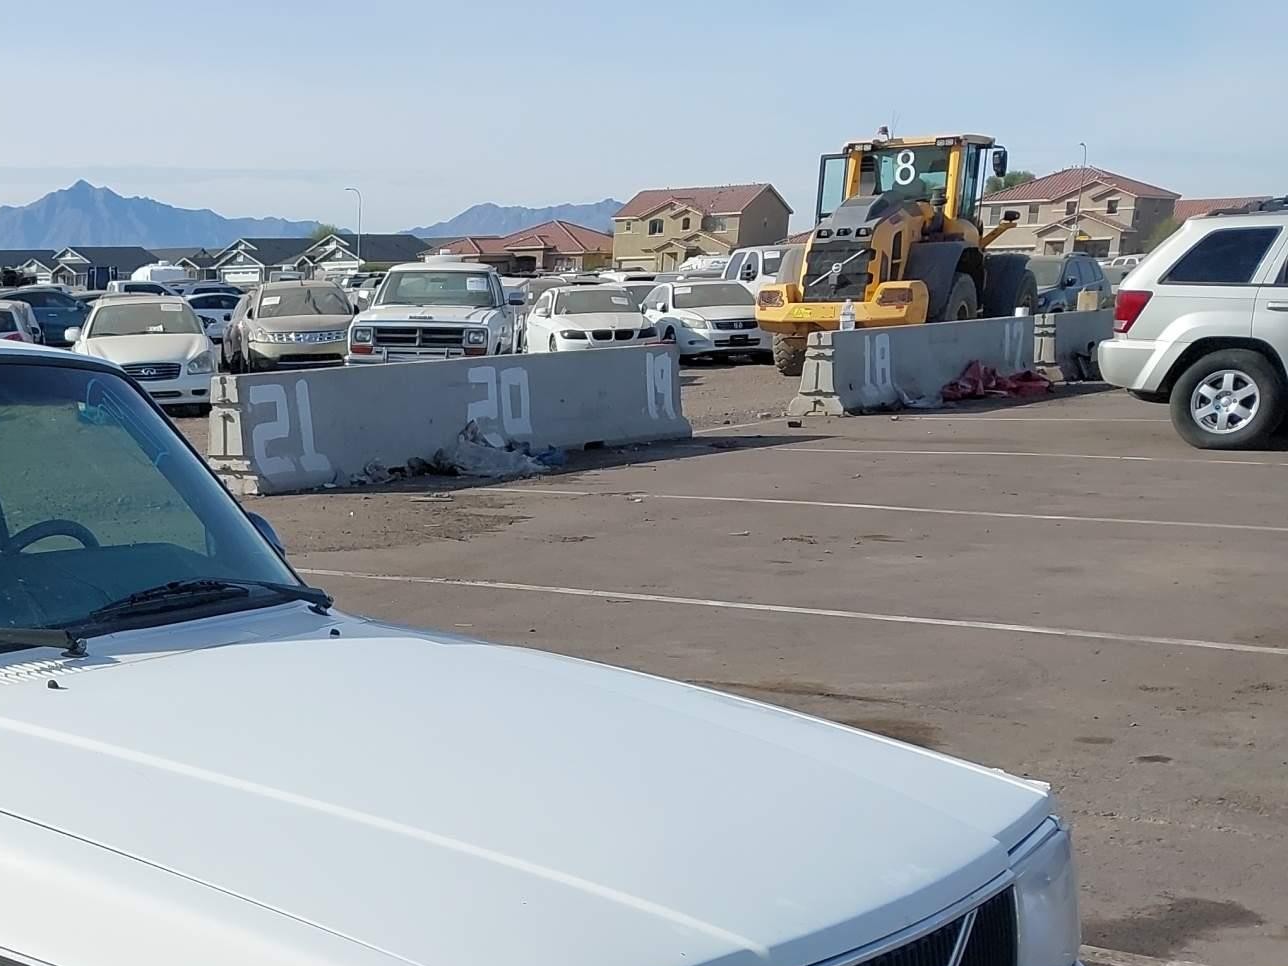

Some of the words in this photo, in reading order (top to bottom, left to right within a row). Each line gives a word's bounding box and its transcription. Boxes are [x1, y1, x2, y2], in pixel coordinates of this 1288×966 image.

[895, 149, 916, 186] 8
[645, 351, 677, 420] 19
[249, 379, 331, 475] 21
